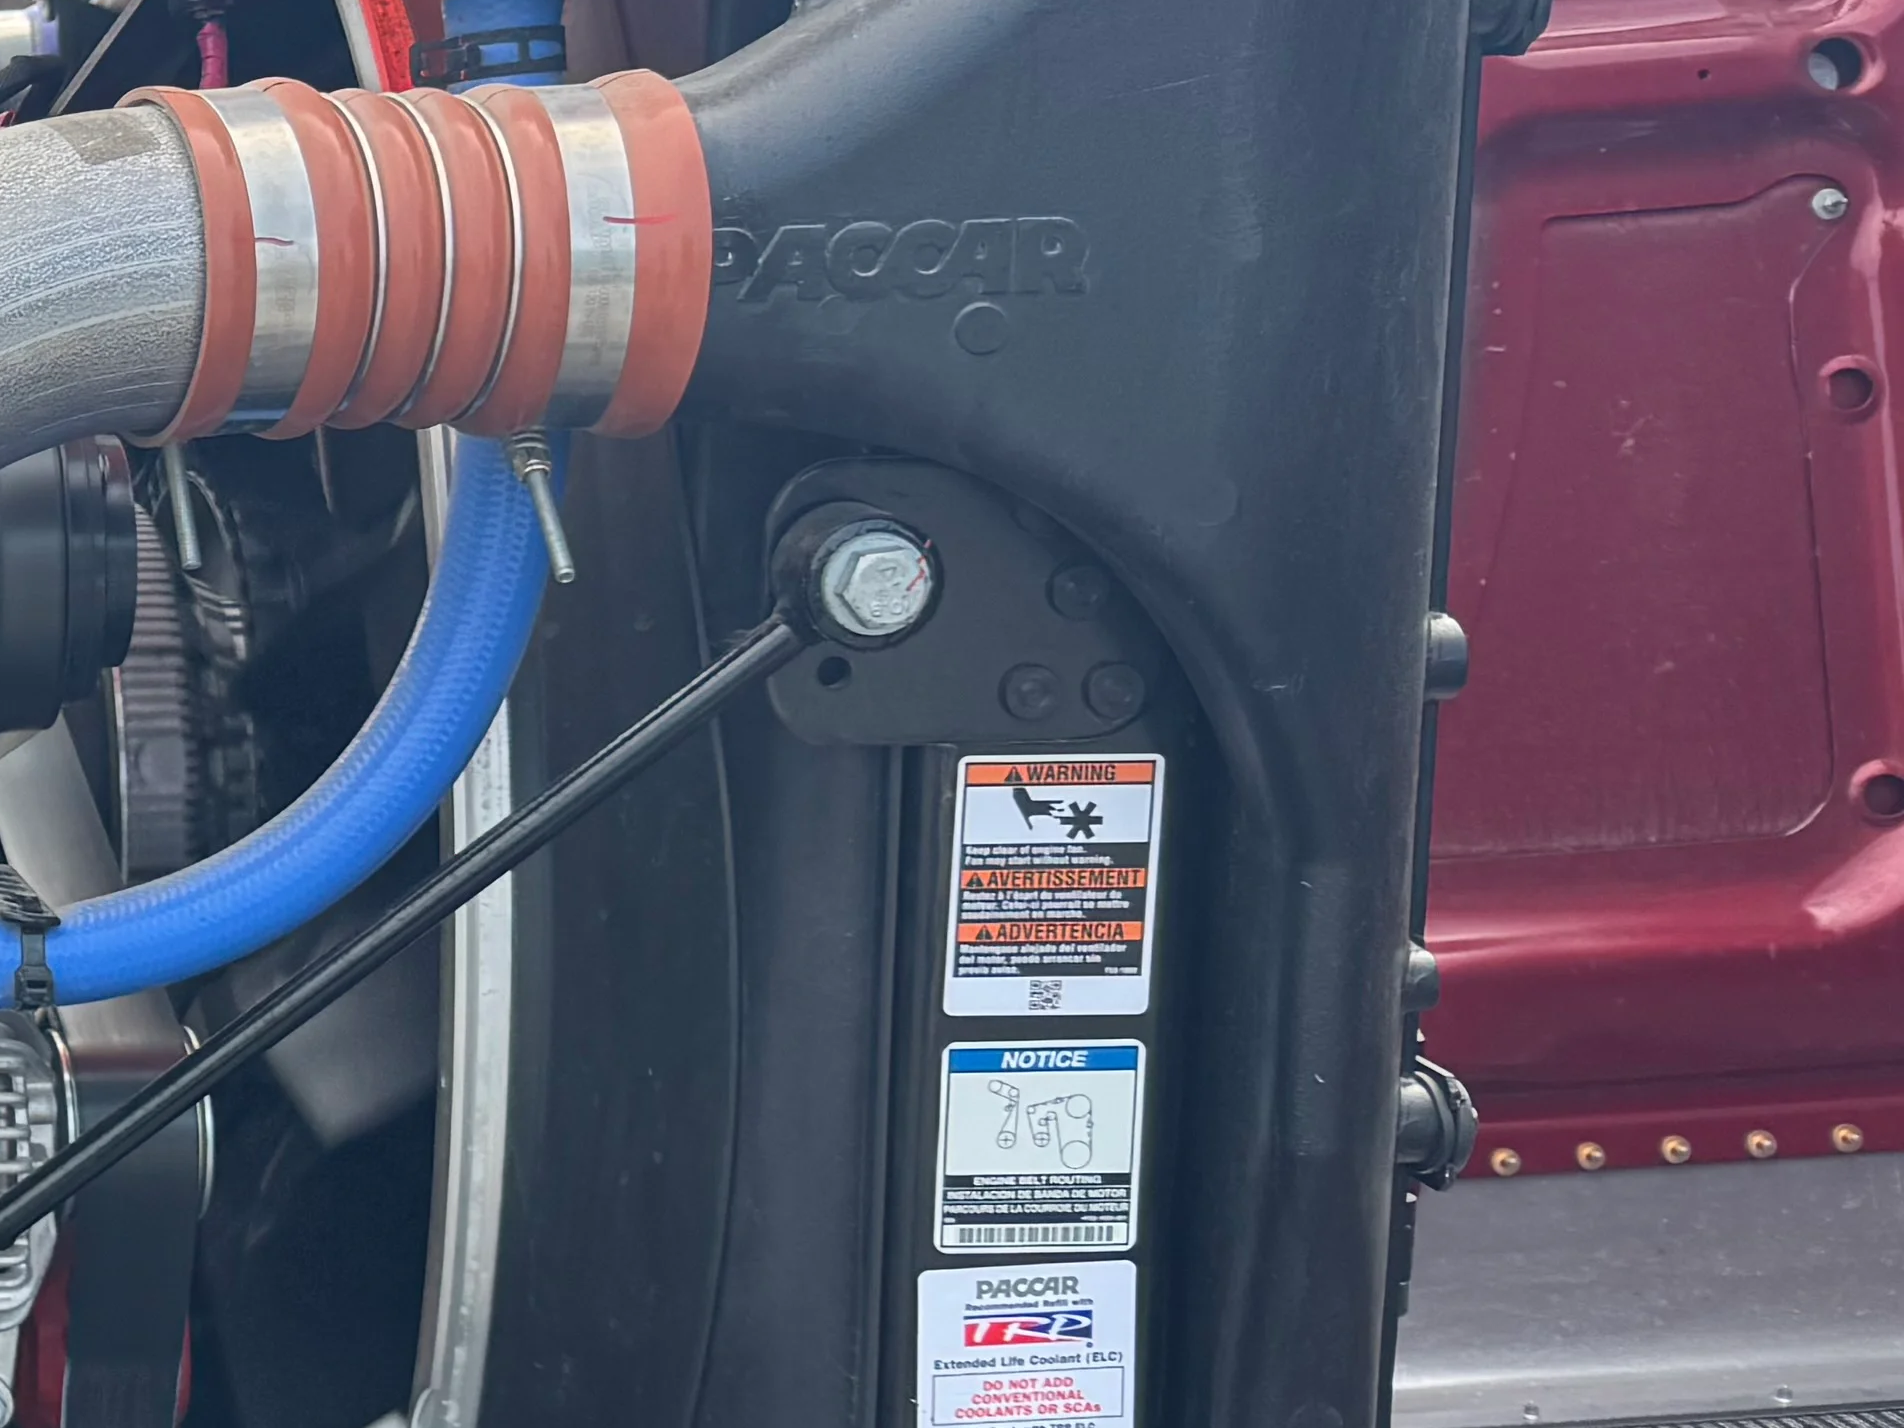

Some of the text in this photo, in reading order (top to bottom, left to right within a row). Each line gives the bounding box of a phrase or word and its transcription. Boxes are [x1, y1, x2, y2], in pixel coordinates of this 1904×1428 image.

[712, 215, 1090, 303] PACCAR
[1026, 765, 1116, 782] WARNING
[987, 868, 1141, 888] AVERTISSEMENT
[996, 923, 1124, 941] ADVERTENCIA
[1001, 1049, 1088, 1071] NOTICE
[973, 1174, 1102, 1186] ENGINE BELT ROUTING
[976, 1275, 1080, 1300] PACCAR
[965, 1298, 1094, 1311] Recommended Refill with
[964, 1313, 1092, 1344] TRP
[934, 1351, 1124, 1371] Extended Life Coolant (ELC)
[983, 1377, 1073, 1391] DO NOT ADD
[971, 1389, 1084, 1405] CONVENTIONAL
[955, 1402, 1101, 1419] COOLANTS OR SCAs
